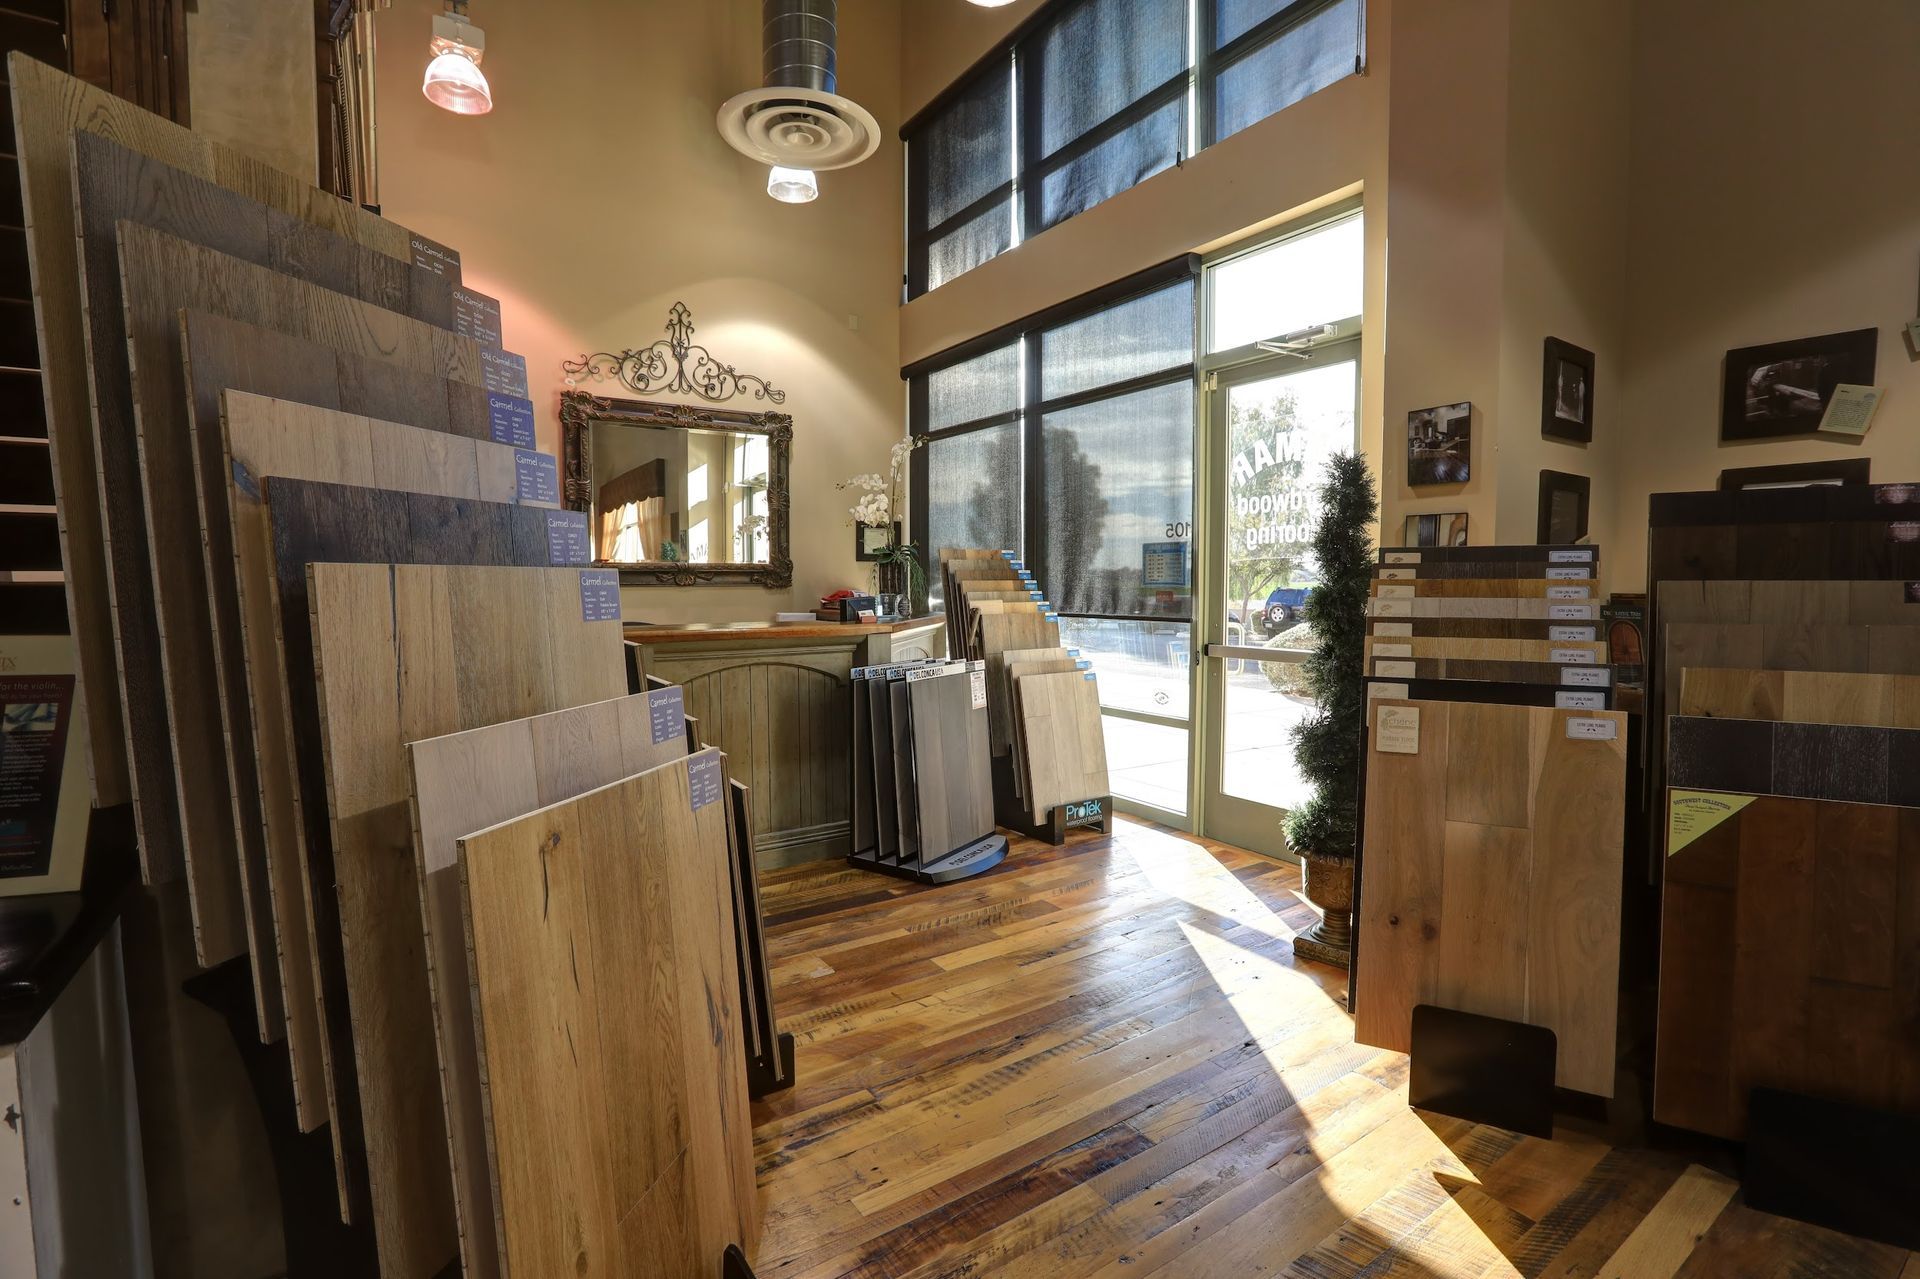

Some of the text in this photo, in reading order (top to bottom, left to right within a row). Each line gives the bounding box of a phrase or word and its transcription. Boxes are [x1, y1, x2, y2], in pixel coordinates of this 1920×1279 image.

[490, 398, 513, 411] Carmel
[516, 454, 538, 467] Carmel
[547, 518, 569, 528] Carmel
[581, 575, 601, 586] Carmel
[14, 680, 29, 690] the
[650, 694, 668, 708] Carmel
[689, 759, 706, 774] Carmel
[1066, 799, 1103, 821] ProTek
